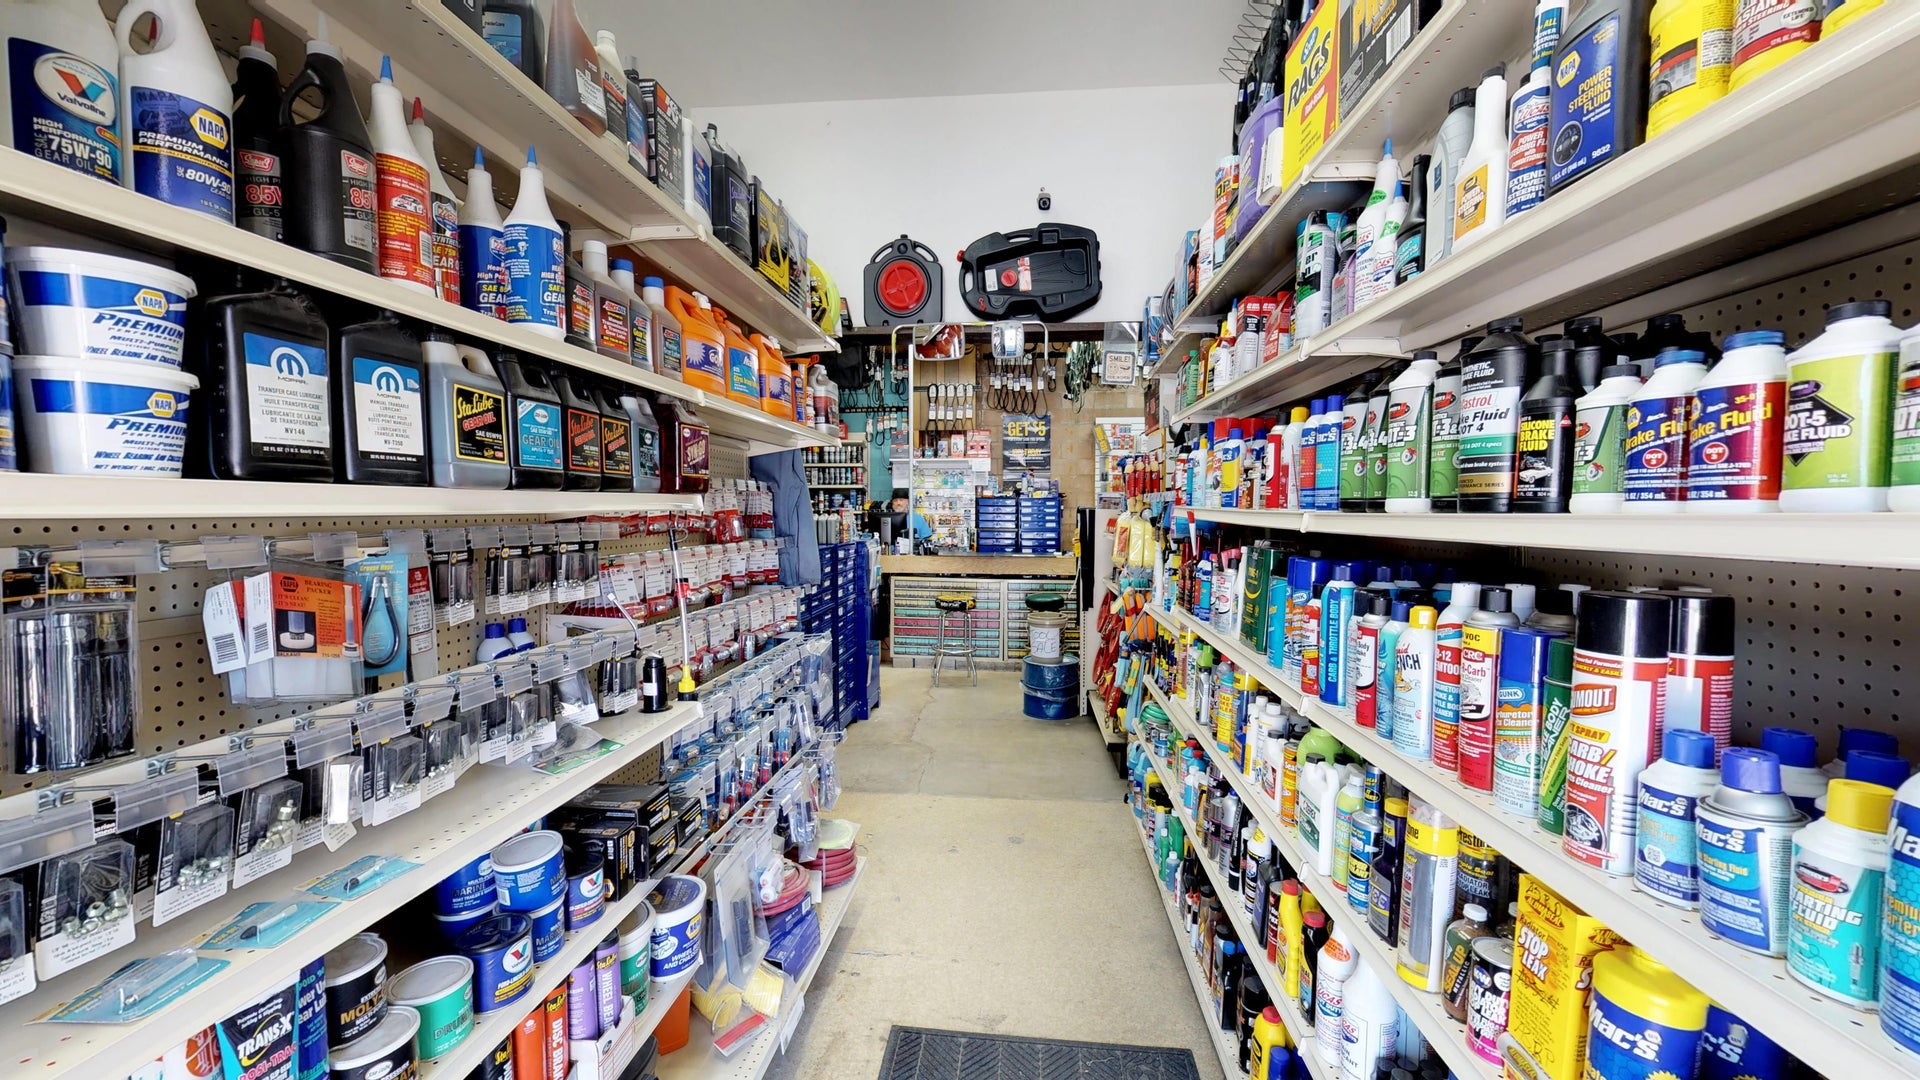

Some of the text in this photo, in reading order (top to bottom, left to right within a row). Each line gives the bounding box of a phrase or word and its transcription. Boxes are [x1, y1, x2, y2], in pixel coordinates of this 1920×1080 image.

[1783, 6, 1815, 20] EXTENDED
[1790, 13, 1805, 22] LIFE
[1287, 30, 1331, 117] RAGS
[1557, 57, 1578, 81] NAPA
[1578, 66, 1612, 95] POWER
[1568, 78, 1612, 114] STEERING
[1583, 91, 1612, 114] FLUID
[57, 92, 106, 118] Valvoline
[33, 117, 63, 130] HIGH
[198, 117, 225, 142] NAPA
[33, 124, 110, 152] PERFORMANCE
[138, 130, 204, 151] PREMIUM
[1518, 131, 1544, 146] POWER
[48, 135, 112, 169] 75W-90
[138, 137, 229, 168] PERFORMANCE
[35, 149, 93, 172] GEAR OIL
[185, 168, 231, 195] 80W-90
[253, 207, 280, 217] GL-5
[482, 284, 498, 292] SAE
[142, 296, 163, 310] NAPA
[603, 301, 626, 314] AMSOIL
[1109, 355, 1131, 363] SMILE!
[277, 376, 306, 385] MOPAR
[1474, 369, 1495, 379] FLUID
[257, 385, 284, 397] TRANSFER
[285, 389, 298, 398] CASE
[376, 393, 402, 401] MOPAR
[154, 398, 173, 412] NAPA
[264, 398, 280, 406] HUILE
[261, 409, 293, 420] LUBRICANTE
[462, 411, 497, 432] GEAR OIL
[1473, 408, 1510, 423] Fluid
[1721, 402, 1772, 430] Fluid
[1007, 421, 1047, 437] GET $5
[1476, 422, 1485, 432] 4
[1521, 419, 1555, 430] SILICONE
[1520, 429, 1555, 440] BRAKE
[1801, 425, 1850, 442] FLUID
[522, 434, 560, 449] GEAR OIL
[1520, 439, 1548, 451] FLUID
[94, 450, 120, 460] WHEEL
[1645, 452, 1662, 460] DOT
[1706, 447, 1724, 455] DOT
[1640, 491, 1653, 499] 354
[1701, 490, 1713, 498] 354
[304, 580, 332, 589] BEARING
[306, 587, 332, 595] PACKER
[1329, 599, 1339, 622] BODY
[1328, 623, 1339, 655] THROTTLE
[1465, 632, 1481, 642] VOC
[1396, 653, 1421, 671] ENCH
[1463, 648, 1484, 662] CRC
[1328, 665, 1338, 682] CARB
[1499, 690, 1521, 699] GUNK
[1545, 697, 1563, 729] BODY
[1575, 727, 1605, 740] SPRAY
[1576, 777, 1615, 796] Cleaner
[1639, 788, 1688, 816] Mac's
[1729, 862, 1749, 876] Fluid
[1469, 884, 1490, 899] LEAK
[1793, 903, 1838, 931] FLUID
[1518, 912, 1547, 940] Radiator
[1518, 925, 1549, 961] STOP
[671, 949, 694, 963] WHEEL
[663, 960, 679, 970] AND
[1444, 944, 1467, 994] SEAL UP
[1521, 950, 1549, 982] LEAK
[1451, 960, 1471, 993] METALLIC
[602, 970, 613, 1004] WHEEL
[298, 1006, 314, 1025] ear
[237, 1011, 295, 1060] TRANS-X
[552, 1017, 564, 1047] DISC
[1590, 1000, 1660, 1062] Mac's
